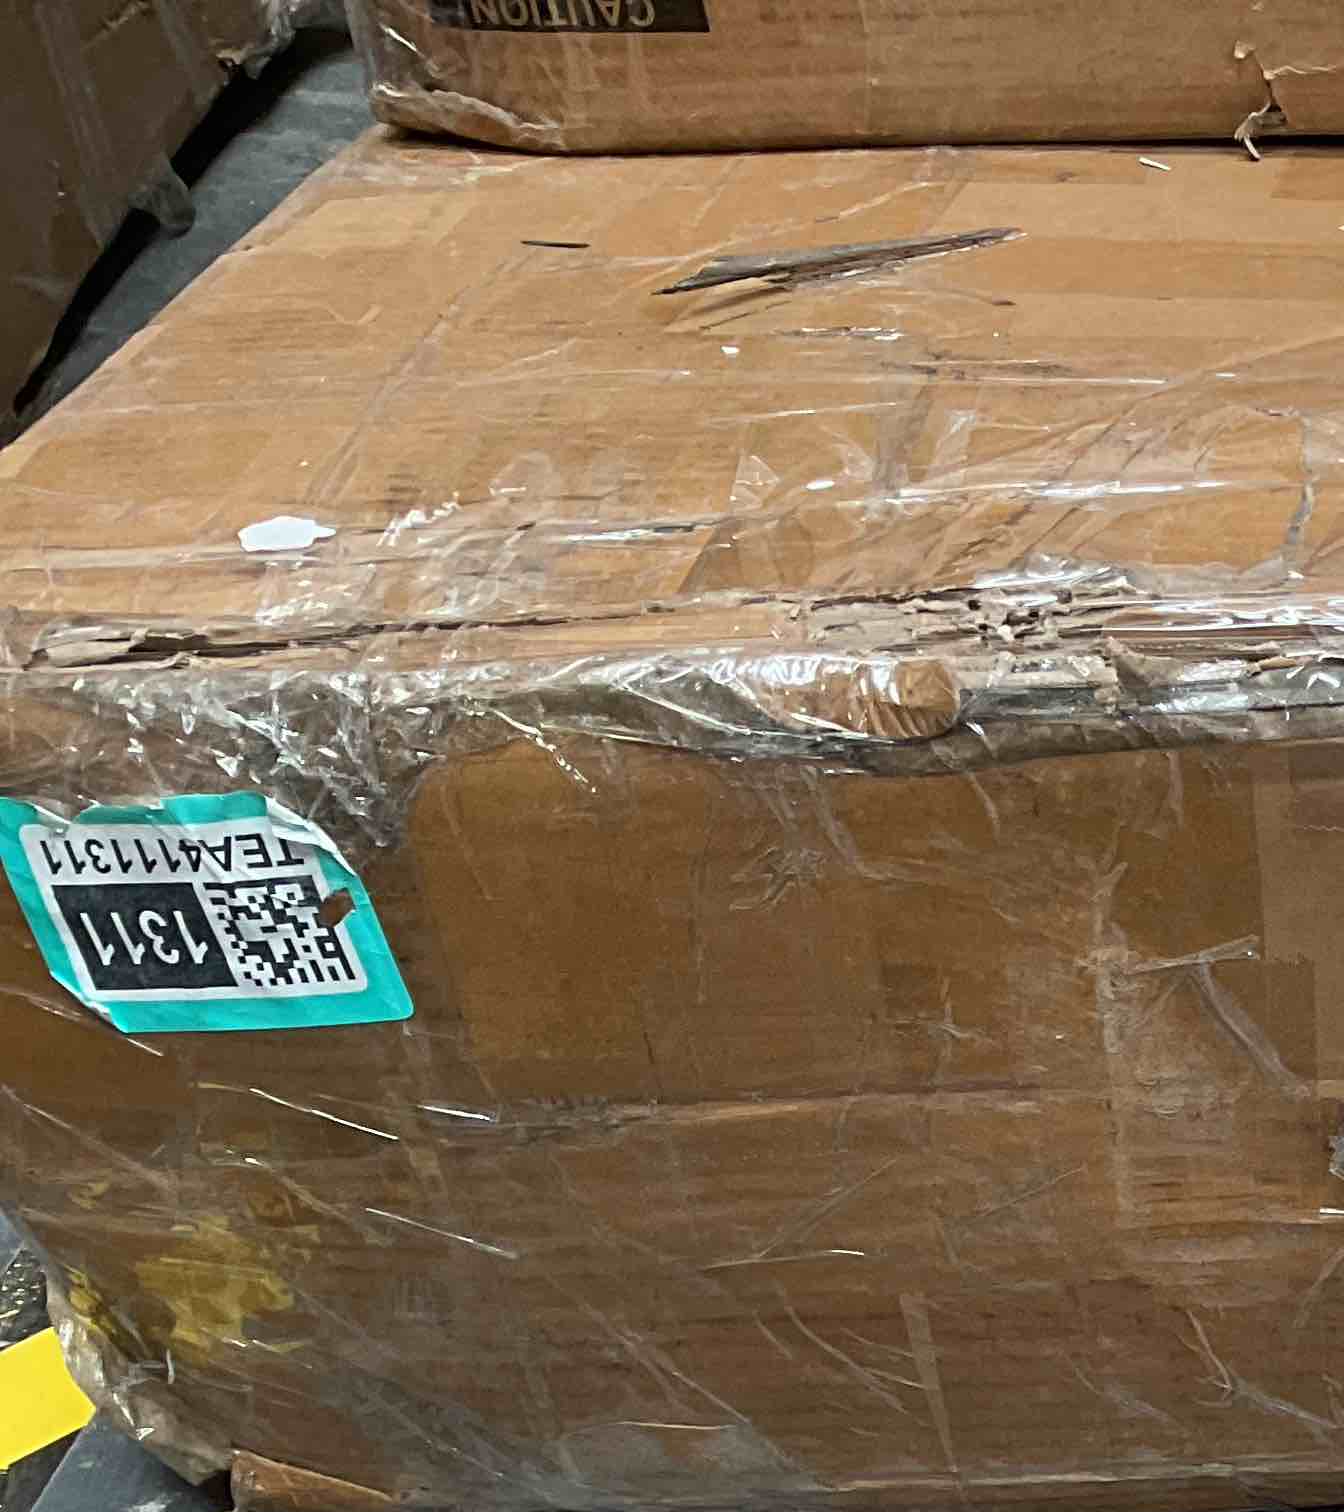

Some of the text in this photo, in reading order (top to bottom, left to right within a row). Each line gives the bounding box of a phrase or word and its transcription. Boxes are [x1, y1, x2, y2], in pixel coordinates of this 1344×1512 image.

[469, 0, 656, 27] CAUTION
[40, 833, 304, 875] TEA4111311
[80, 910, 209, 966] 1311
